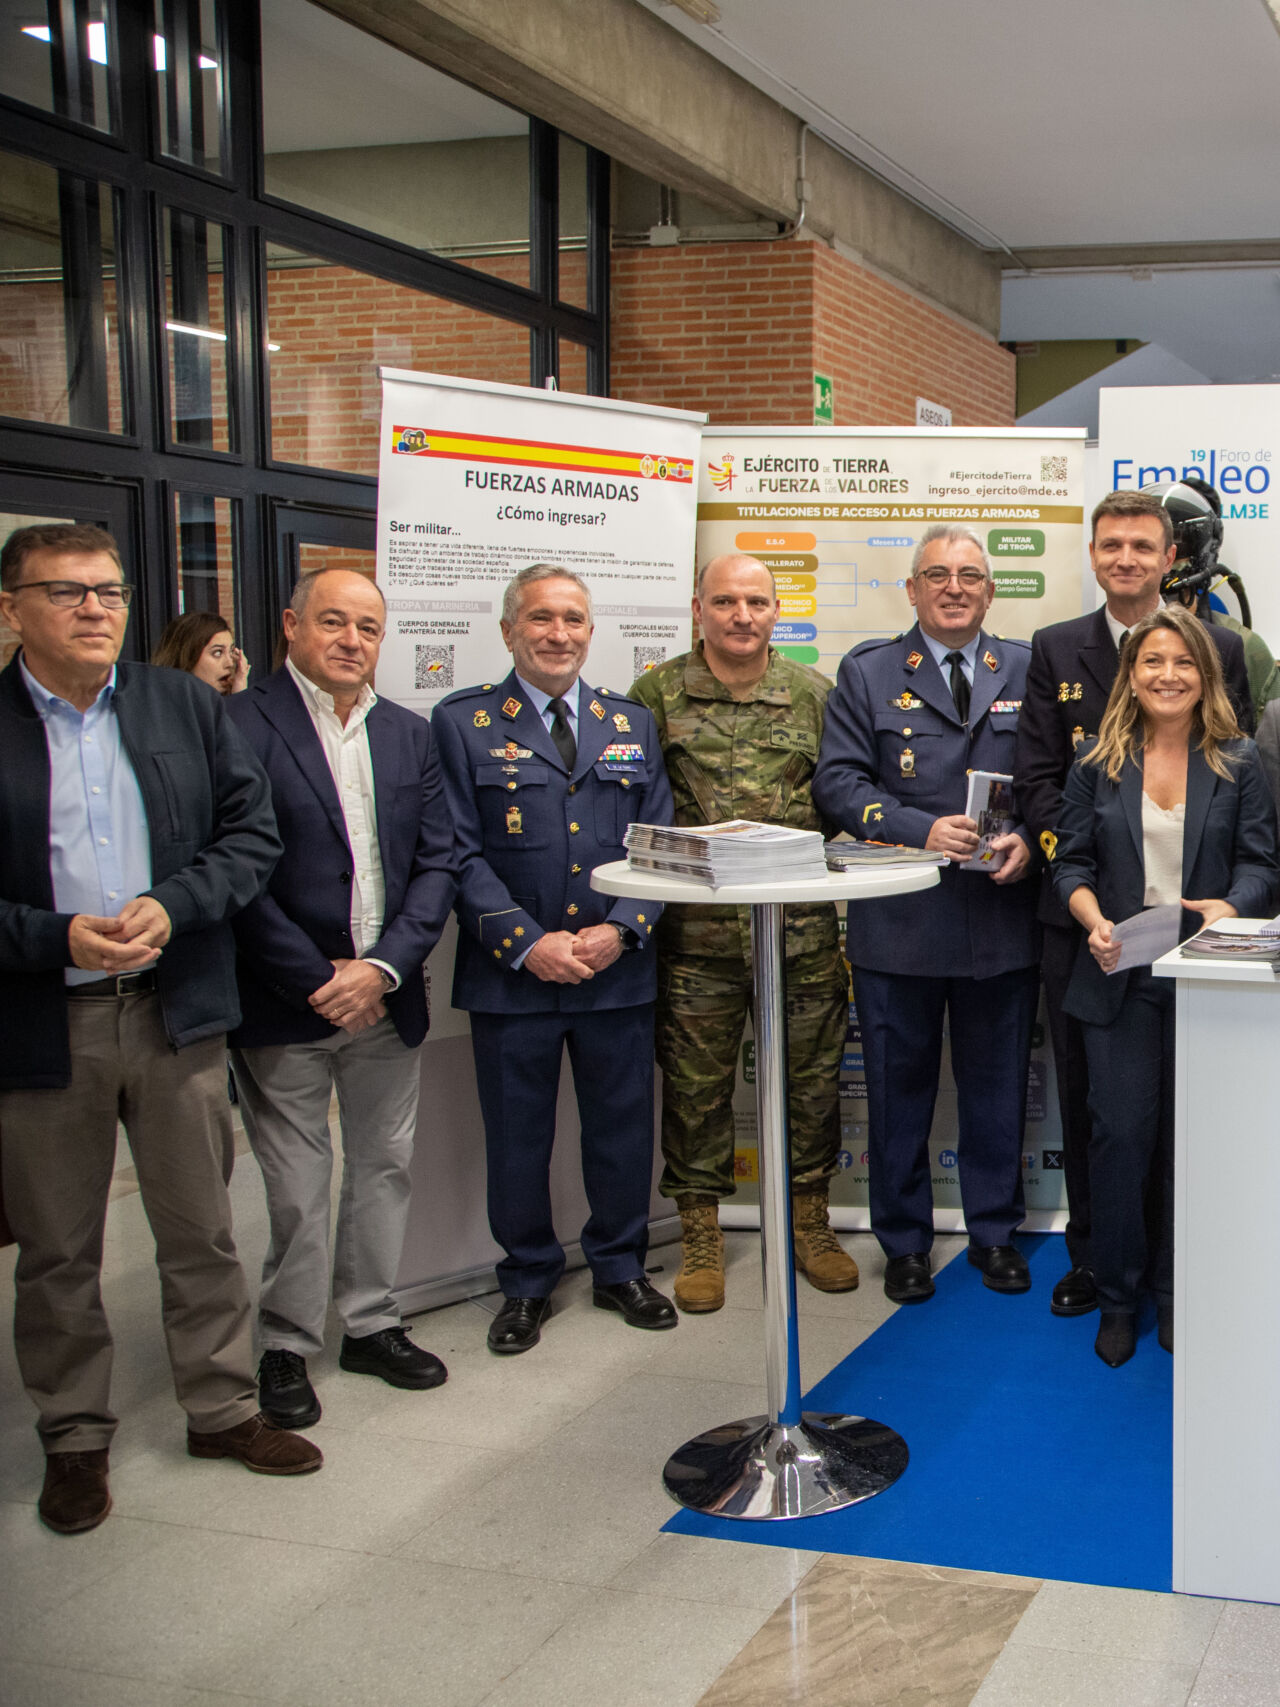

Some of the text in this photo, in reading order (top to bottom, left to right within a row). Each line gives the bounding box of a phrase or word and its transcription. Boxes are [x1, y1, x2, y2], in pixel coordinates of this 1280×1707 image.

[920, 407, 943, 426] ASEOS
[1190, 450, 1206, 462] 19
[1220, 449, 1272, 462] Foro de
[744, 454, 819, 473] EJÉRCITO
[833, 458, 890, 473] TIERRA
[950, 471, 1032, 482] #EjercitodeTierra
[464, 469, 640, 502] FUERZAS ARMADAS
[758, 478, 821, 493] FUERZA
[837, 478, 909, 494] VALORES
[928, 484, 1068, 498] ingreso_ejercito@mde.es
[496, 505, 607, 527] ¿Cómo ingresar?
[737, 506, 1040, 519] TITULACIONES DE ACCESO A LAS FUERZAS ARMADAS
[1220, 504, 1269, 519] LM3E
[389, 520, 462, 536] Ser militar...
[872, 538, 895, 546] Meses
[1002, 536, 1032, 544] MILITAR
[388, 600, 421, 611] TROPA
[424, 601, 431, 610] Y
[398, 620, 429, 628] CUERPOS
[430, 620, 466, 628] GENERALES
